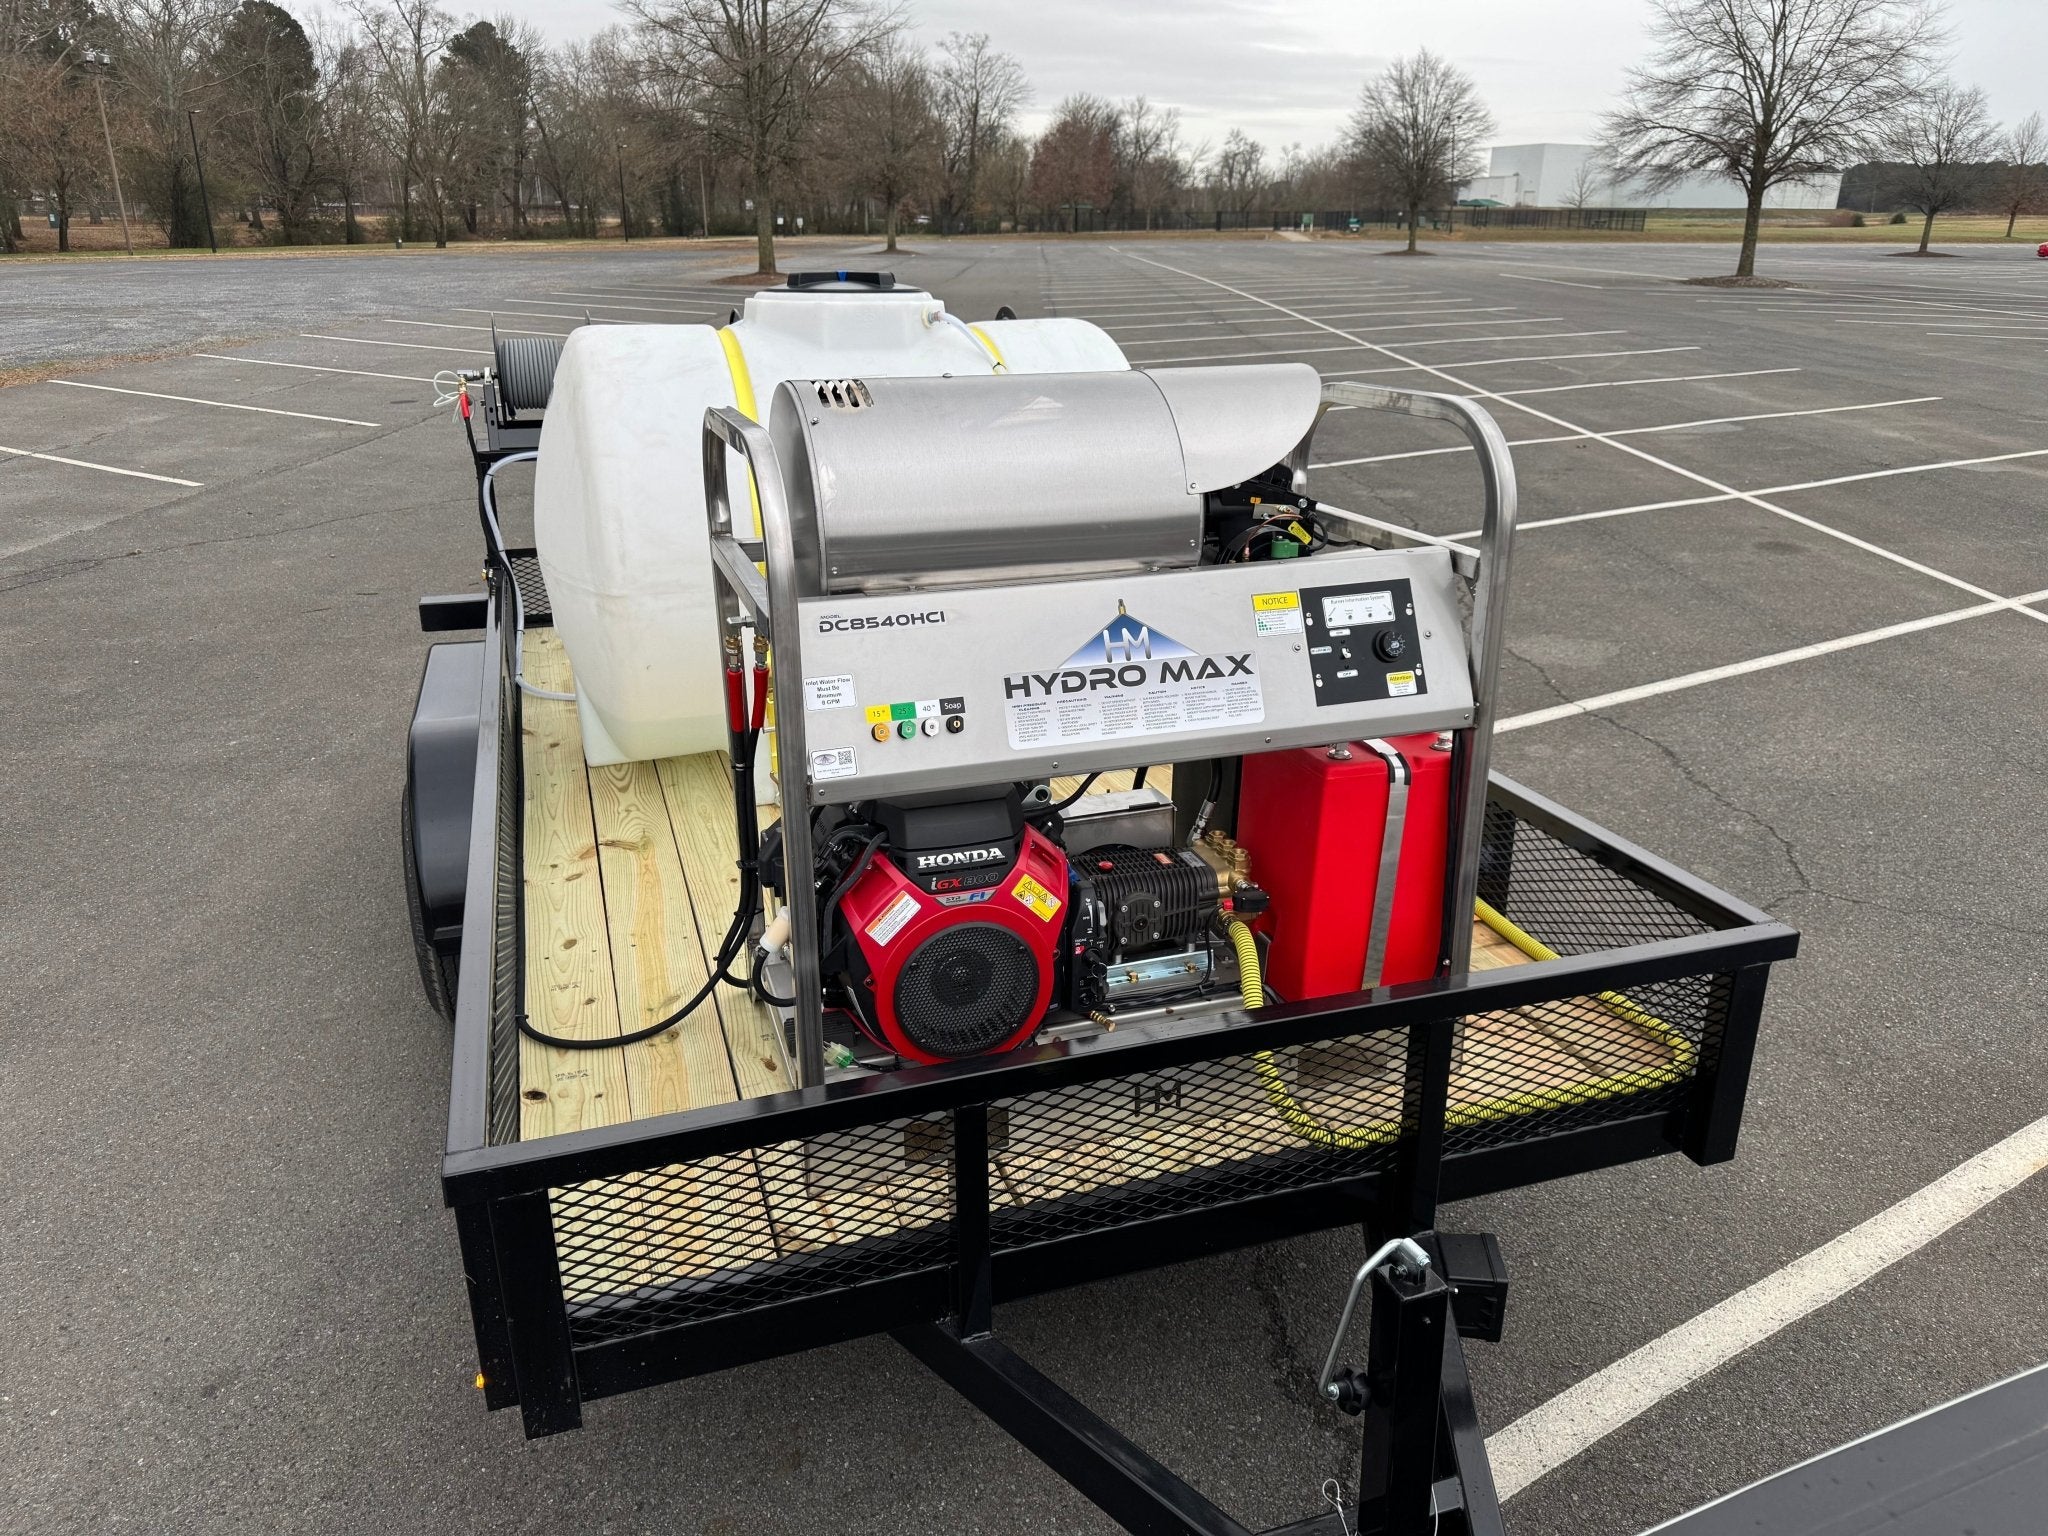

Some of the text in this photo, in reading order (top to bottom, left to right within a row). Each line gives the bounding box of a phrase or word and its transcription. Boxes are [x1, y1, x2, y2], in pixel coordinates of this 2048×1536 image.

[1262, 597, 1288, 606] NOTICE
[819, 611, 946, 633] DC8540HCI
[1102, 626, 1152, 663] HM
[1003, 654, 1255, 700] HYDRO MAX
[944, 702, 962, 711] Soap
[916, 847, 1006, 869] HONDA
[968, 891, 986, 901] FI
